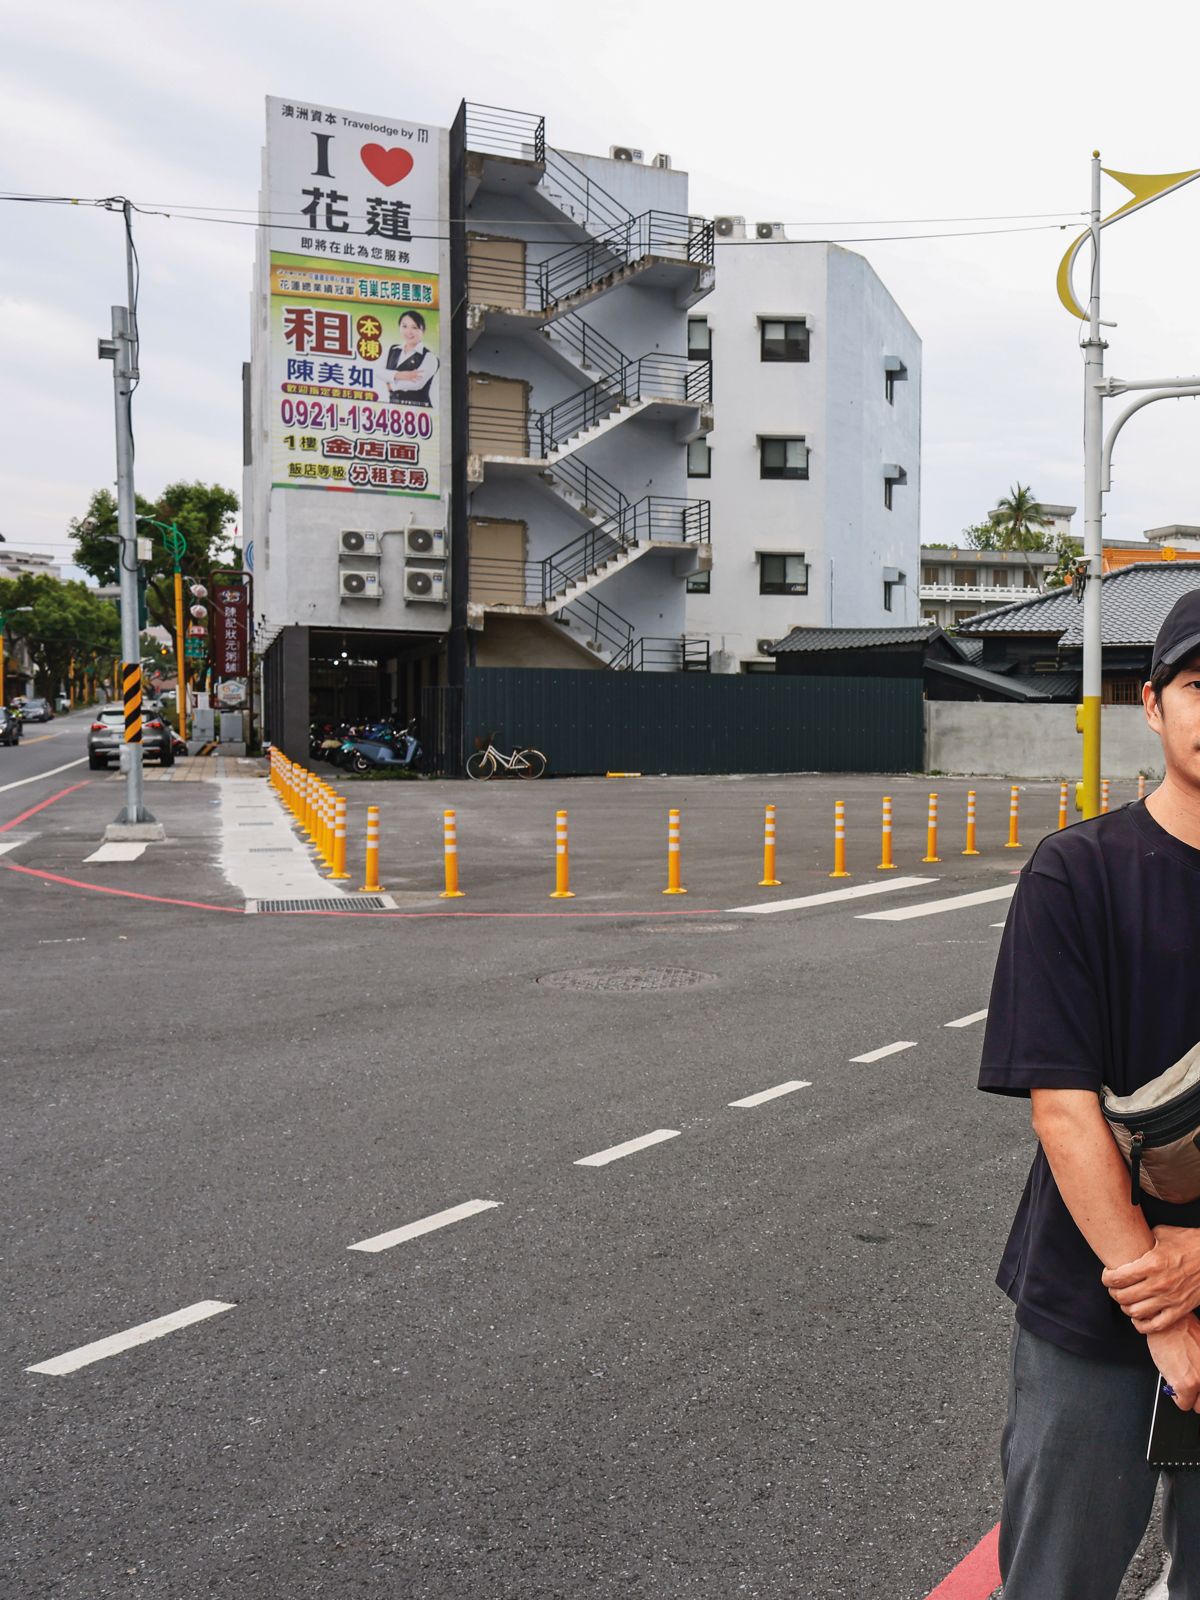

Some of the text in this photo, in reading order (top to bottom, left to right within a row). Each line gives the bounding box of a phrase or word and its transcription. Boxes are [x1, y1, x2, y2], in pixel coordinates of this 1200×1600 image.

[281, 104, 337, 125] 澳洲資本
[342, 117, 398, 136] Travelodge
[401, 128, 413, 139] by
[311, 132, 335, 179] I
[302, 187, 412, 242] 花蓮
[301, 237, 410, 264] 即將在此為您服務
[358, 279, 432, 304] 有巢氏明星團隊
[284, 308, 352, 357] 租
[359, 318, 380, 359] 本棟
[287, 359, 374, 388] 陳美如
[281, 399, 430, 437] 0921-134880
[283, 435, 417, 461] 1樓 金店面
[288, 463, 425, 487] 飯店等級 分租套房
